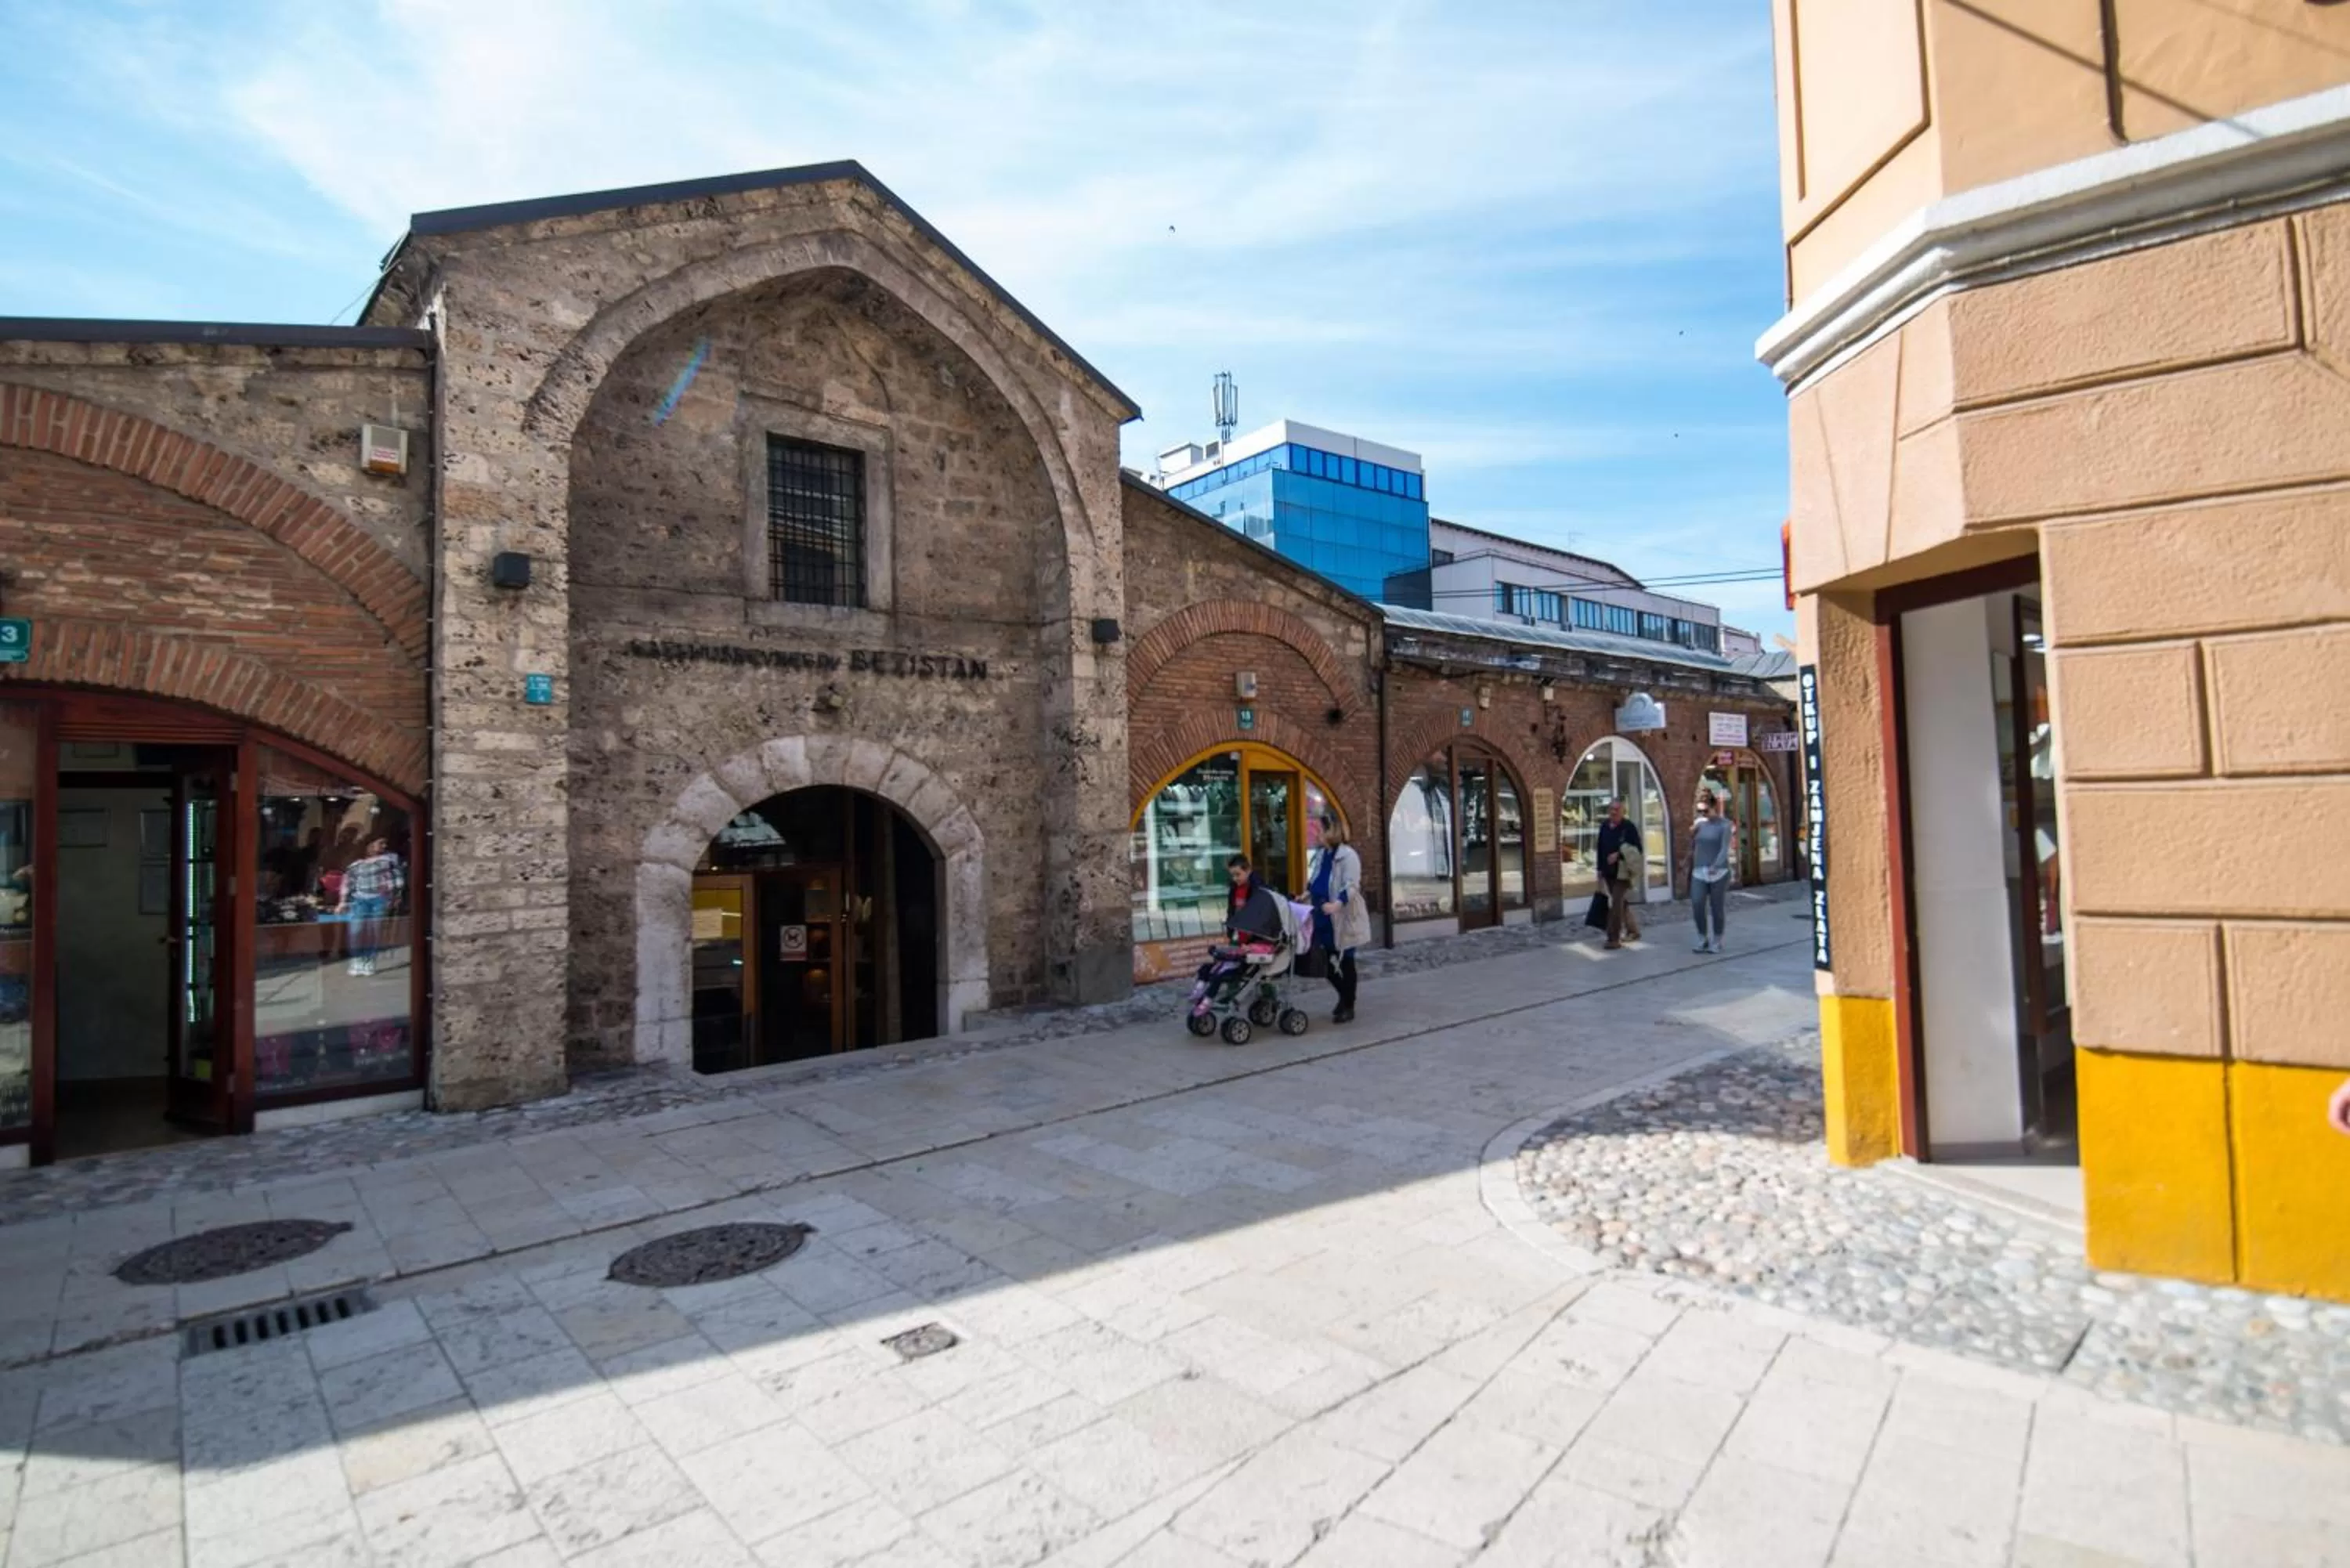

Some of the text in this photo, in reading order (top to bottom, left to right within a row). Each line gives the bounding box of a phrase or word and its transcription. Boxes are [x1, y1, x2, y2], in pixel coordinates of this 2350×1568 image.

[849, 649, 987, 680] BEZISTAN
[1802, 674, 1828, 963] OTKUP I ZAMJENA ZLATA
